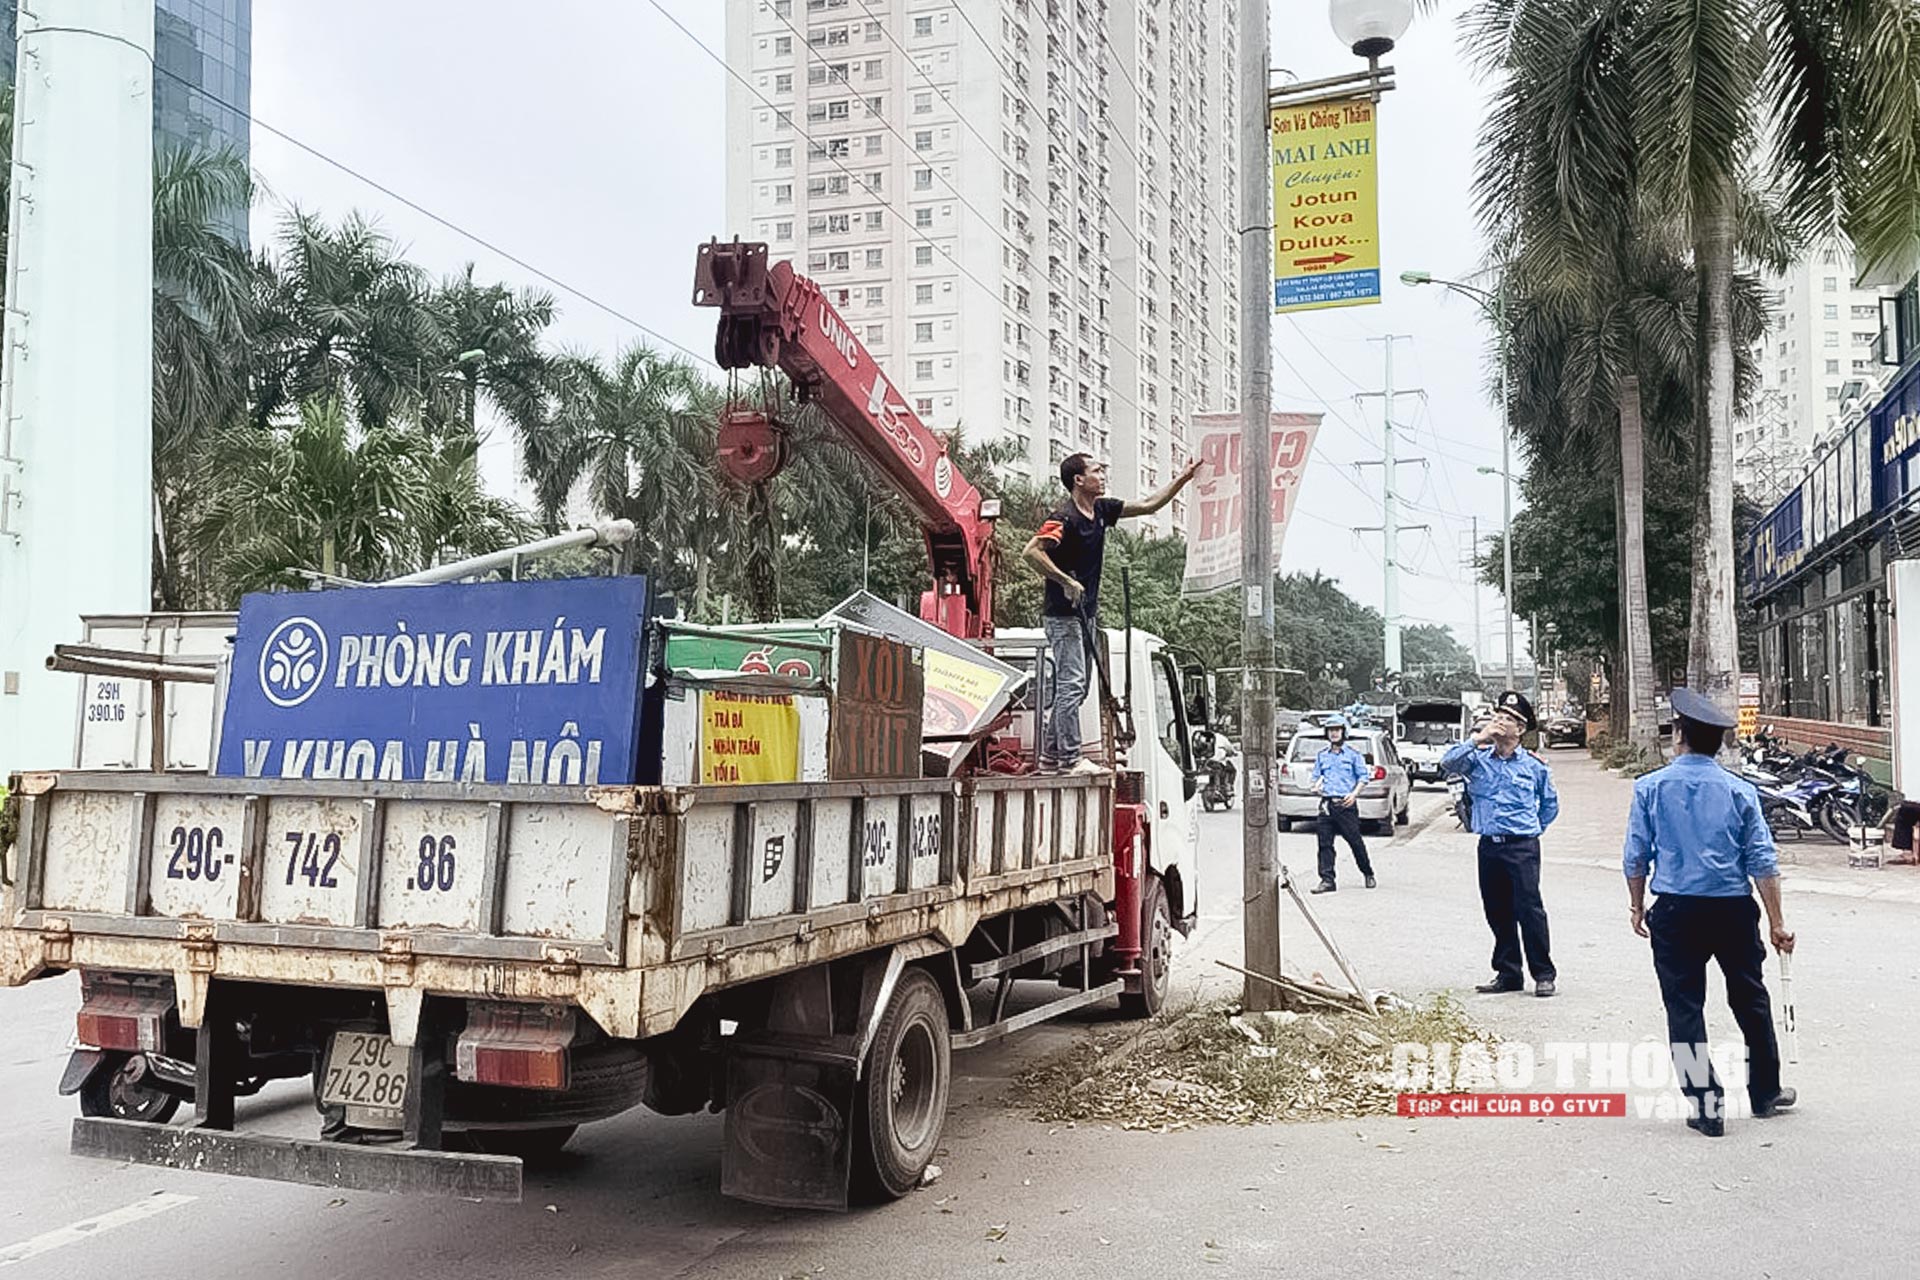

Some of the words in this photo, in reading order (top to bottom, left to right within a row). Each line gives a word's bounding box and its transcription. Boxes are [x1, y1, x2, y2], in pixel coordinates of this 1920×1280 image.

[1274, 144, 1316, 166] MAI
[1322, 138, 1371, 161] ANH
[1290, 191, 1358, 208] Jotun
[1294, 212, 1353, 229] Kova
[819, 302, 858, 368] UNIC
[334, 621, 472, 689] PHÒNG
[480, 616, 607, 686] KHÁM
[854, 634, 906, 702] XÔI
[97, 682, 120, 701] 29H
[88, 703, 126, 722] 390.16
[281, 739, 404, 781] KHOA
[423, 723, 487, 783] HÀ
[167, 826, 234, 882] 29C-
[285, 832, 342, 888] 742
[406, 834, 456, 892] .86
[348, 1034, 393, 1068] 29C
[325, 1068, 406, 1105] 742.86
